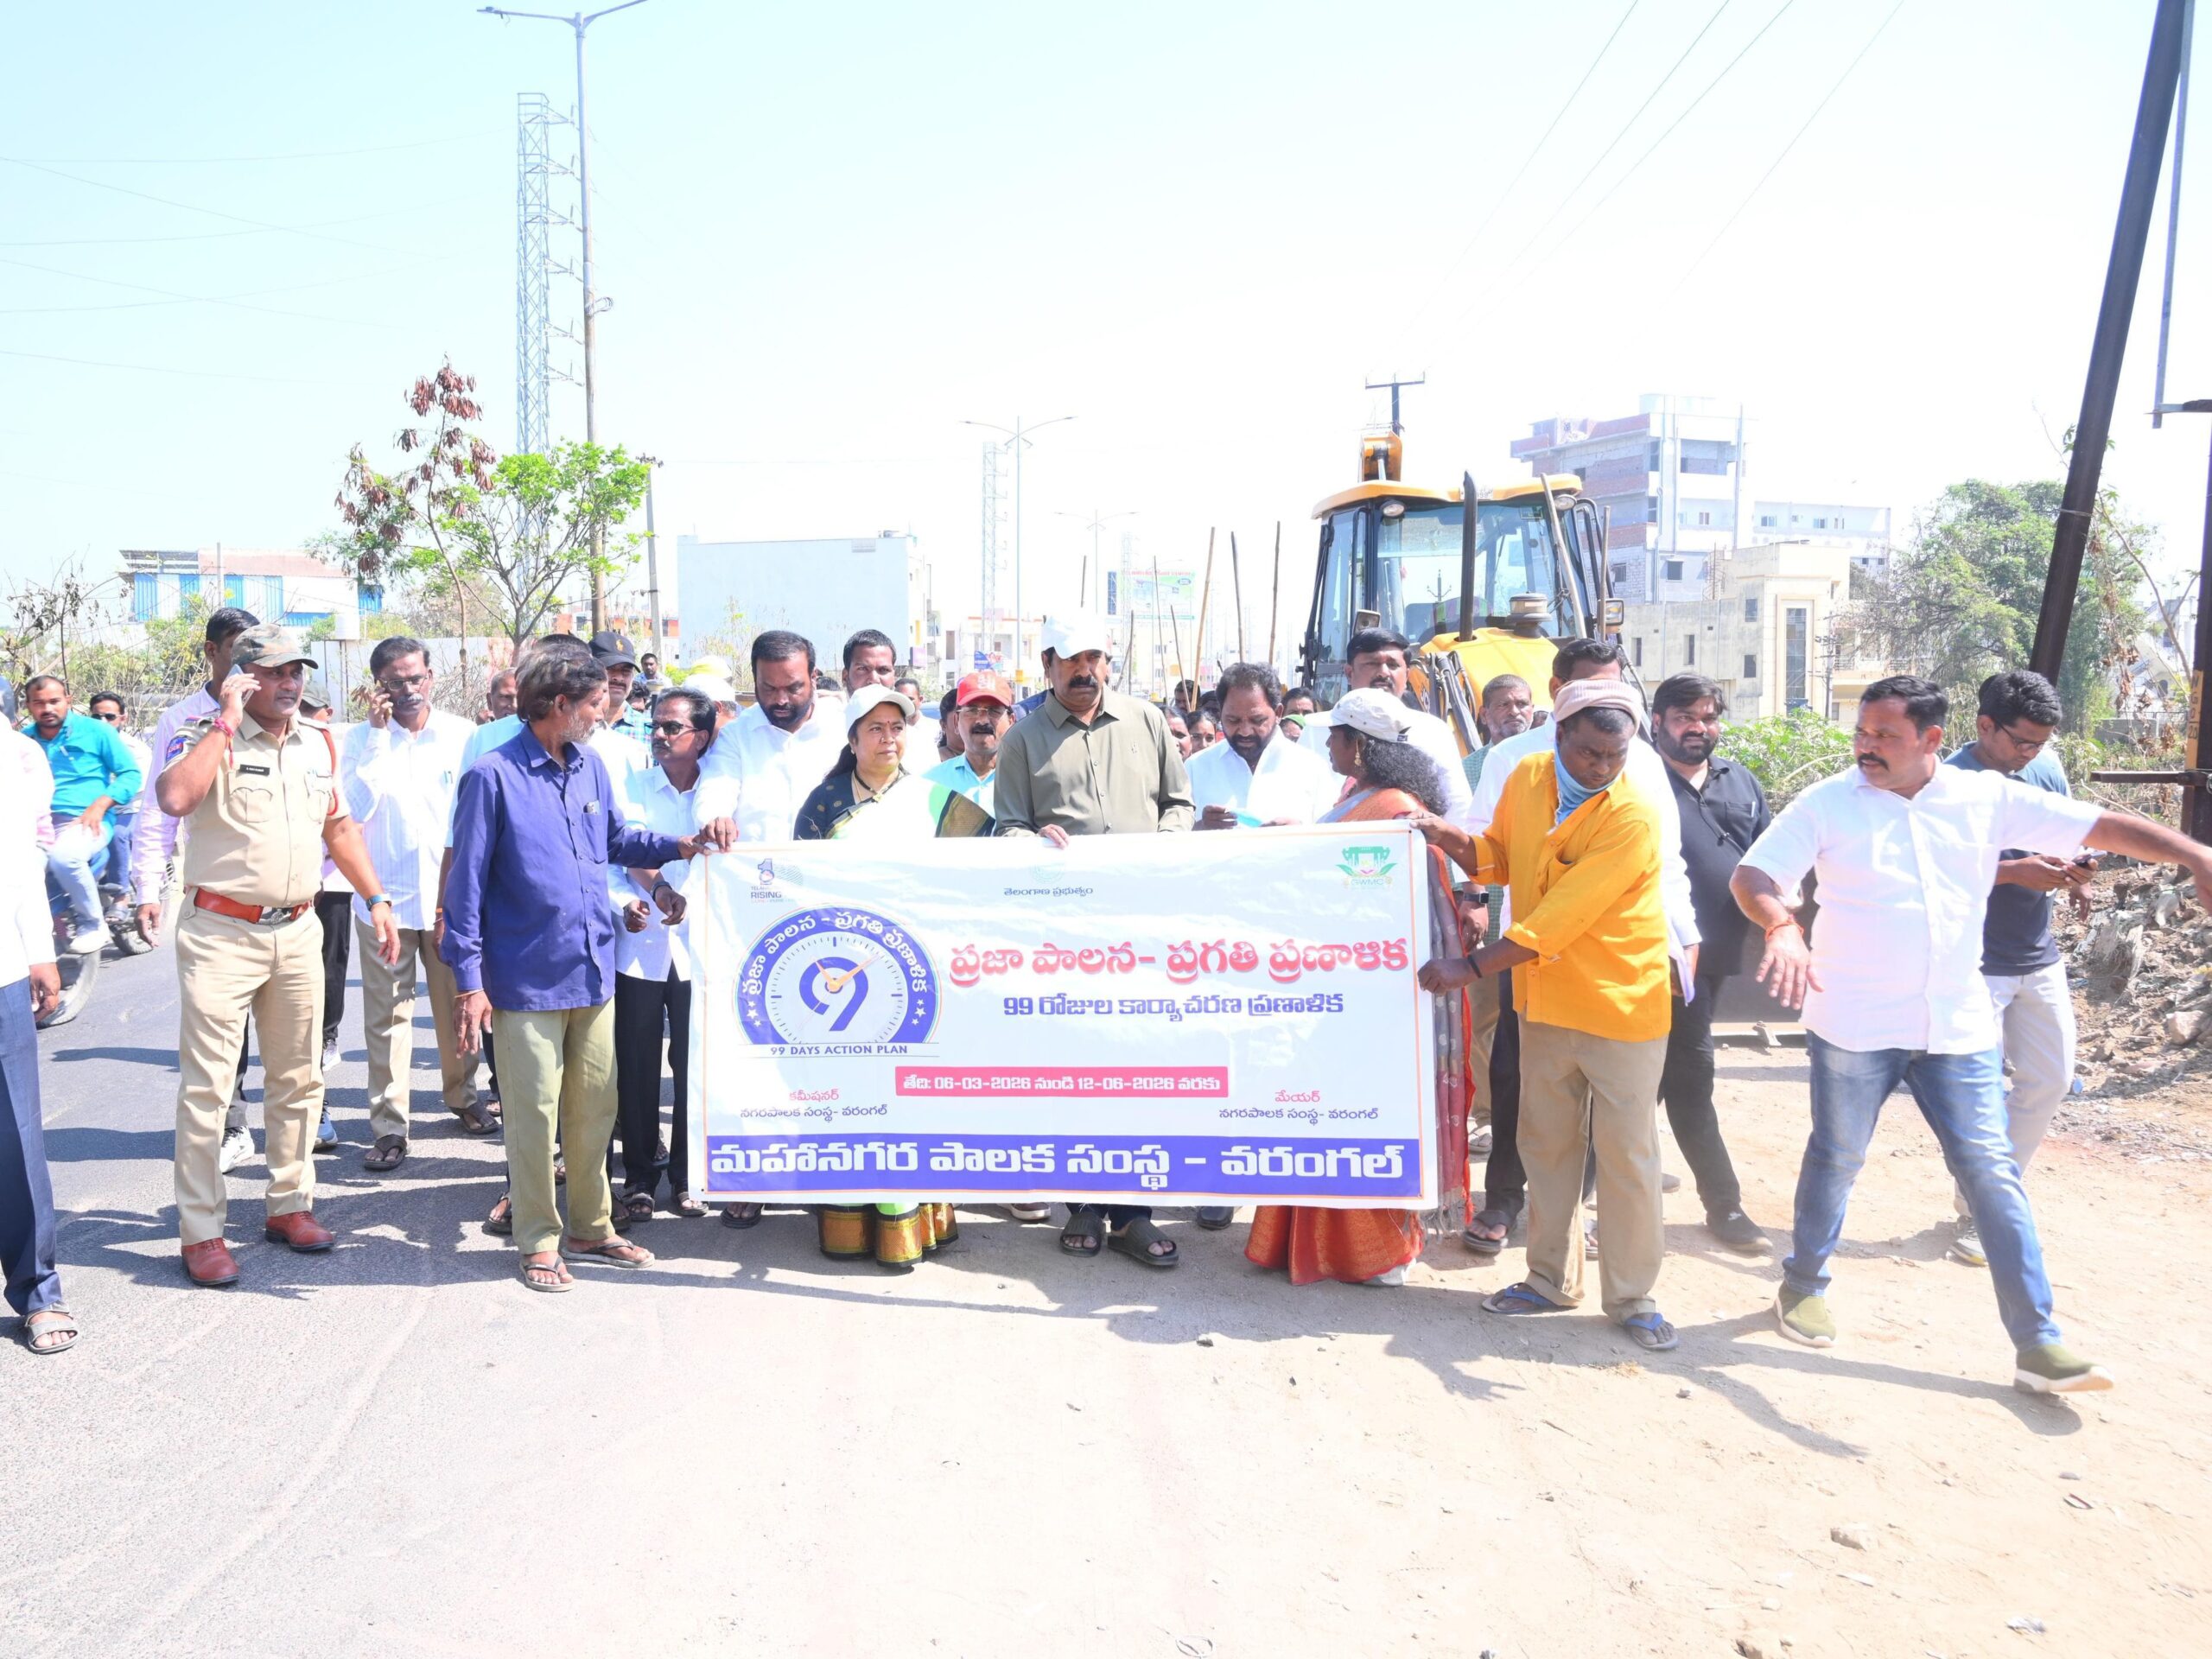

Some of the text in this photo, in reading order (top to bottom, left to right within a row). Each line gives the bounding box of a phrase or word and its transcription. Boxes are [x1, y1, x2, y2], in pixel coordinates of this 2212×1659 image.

[1003, 886, 1094, 897] తెలంగాణ ప్రభుత్వం
[742, 955, 766, 995] ప్రజా
[764, 915, 817, 955] పాలన
[834, 911, 883, 934] ప్రగతి
[881, 929, 927, 993] ప్రణాళిక
[949, 943, 1024, 988] ప్రజా
[1166, 938, 1260, 985] ప్రగతి
[1268, 938, 1409, 984] ప్రణాళిక
[1003, 993, 1344, 1022] 99 రోజుల కార్యాచరణ ప్రణాళిక
[770, 1045, 908, 1055] 99 DAYS ACTION PLAN
[934, 1077, 1032, 1090] 06-03-2026
[1034, 1075, 1074, 1090] నుండి
[1077, 1077, 1175, 1090] 12-06-2026
[1178, 1077, 1221, 1091] వరకు
[1274, 1089, 1321, 1103] మేయర్
[740, 1107, 801, 1118] నగరపాలక
[842, 1103, 888, 1116] వరంగల్
[1219, 1107, 1284, 1119] నగరపాలక
[1328, 1107, 1379, 1120] వరంగల్
[710, 1141, 918, 1173] మహానగర
[929, 1141, 1056, 1173] పాలక
[1066, 1143, 1170, 1191] సంస్థ
[1220, 1144, 1405, 1179] వరంగల్
